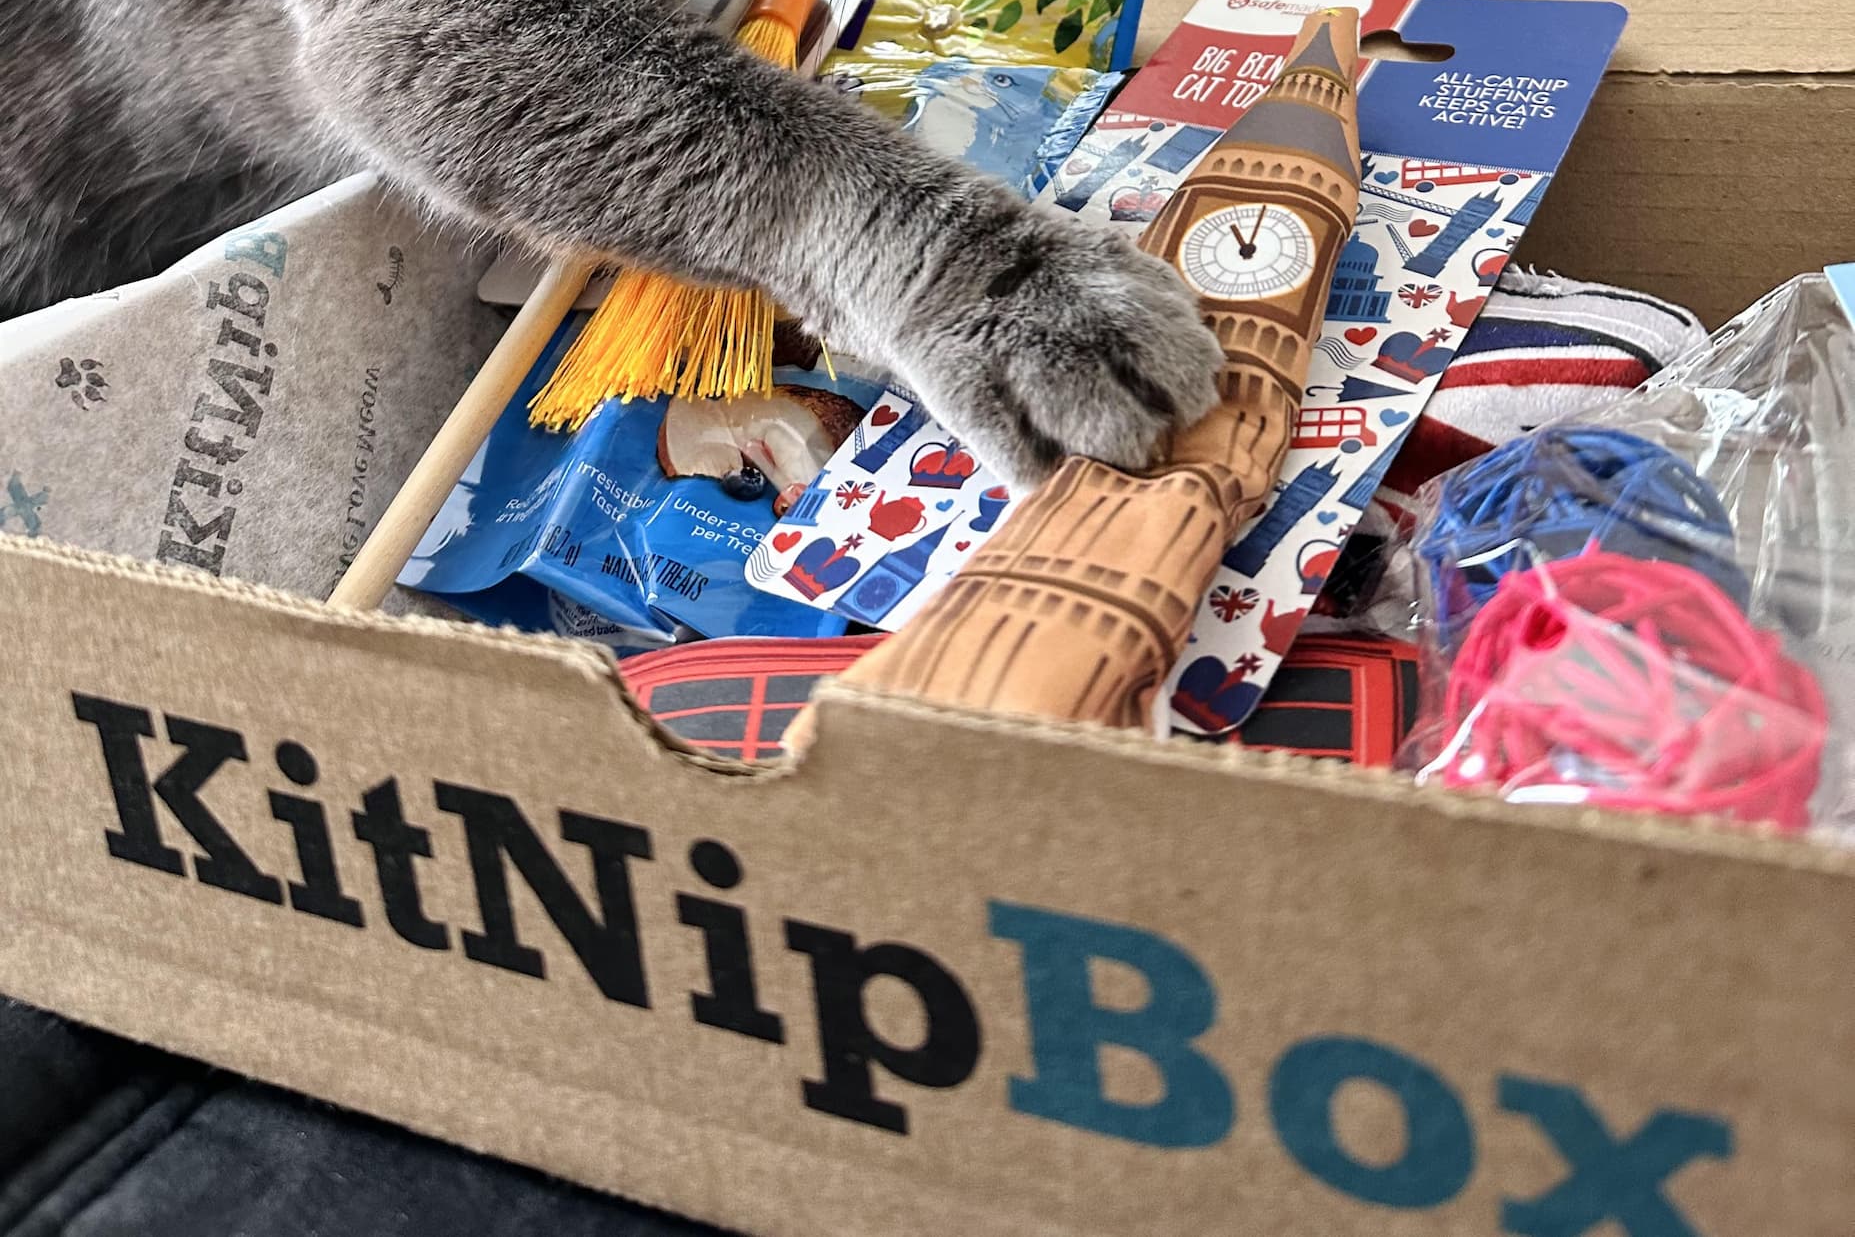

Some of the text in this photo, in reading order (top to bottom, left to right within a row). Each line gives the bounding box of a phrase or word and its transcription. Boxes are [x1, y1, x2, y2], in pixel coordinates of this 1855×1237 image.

[1192, 45, 1288, 82] BIG BEN
[1172, 73, 1272, 109] CAT TOY
[1433, 72, 1569, 92] ALL-CATNIP
[1436, 84, 1551, 105] STUFFING
[1418, 95, 1556, 119] KEEPS CATS
[1432, 111, 1527, 130] ACTIVE!
[577, 461, 656, 510] Irresistible
[591, 486, 628, 523] Taste
[673, 497, 727, 529] Under
[726, 521, 742, 533] 2
[690, 525, 726, 543] per
[656, 558, 709, 602] TREATS
[72, 690, 1736, 1237] KitNipBox
